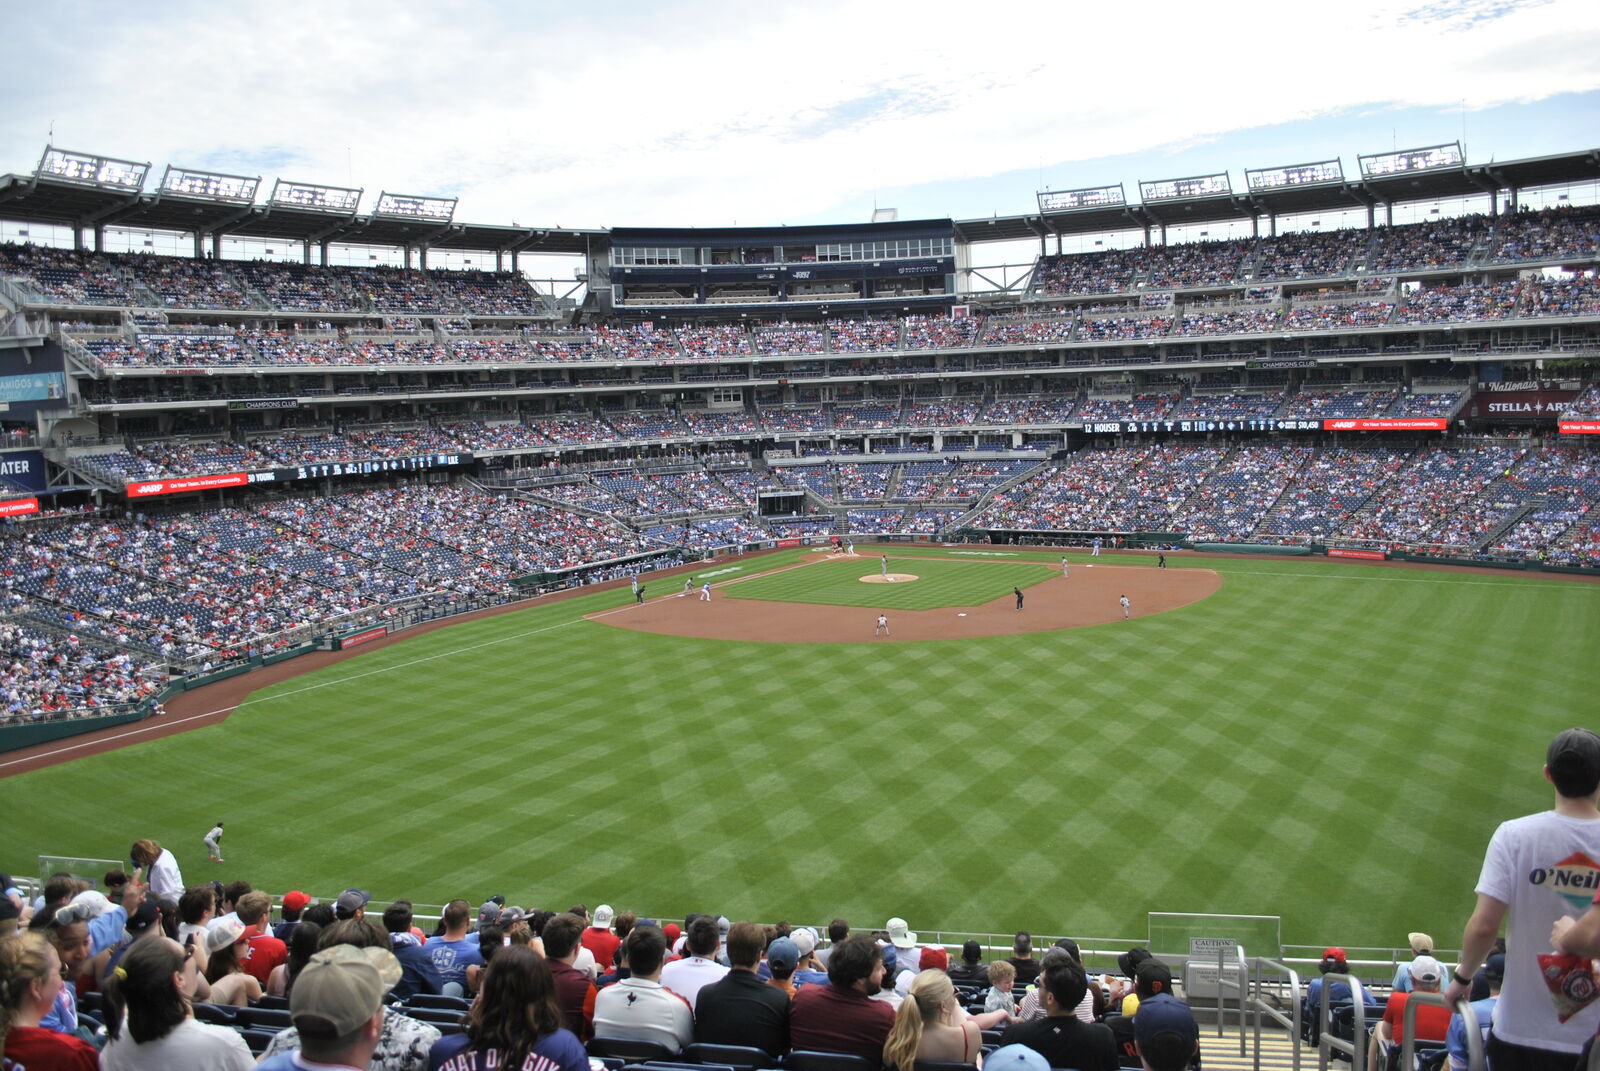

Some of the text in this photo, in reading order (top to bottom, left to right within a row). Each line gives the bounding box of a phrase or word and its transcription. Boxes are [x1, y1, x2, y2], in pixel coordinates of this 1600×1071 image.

[1488, 381, 1539, 392] Nationals
[246, 401, 281, 409] CHAMPIONS
[281, 400, 297, 408] CLUB
[1488, 403, 1532, 412] STELLA
[1084, 423, 1120, 433] 12 HOUSER
[1298, 421, 1319, 430] $10,450
[1, 460, 30, 475] ATER
[217, 476, 241, 484] Community.
[256, 472, 275, 482] YOUNG
[138, 483, 163, 494] AARP
[9, 502, 35, 511] Community.
